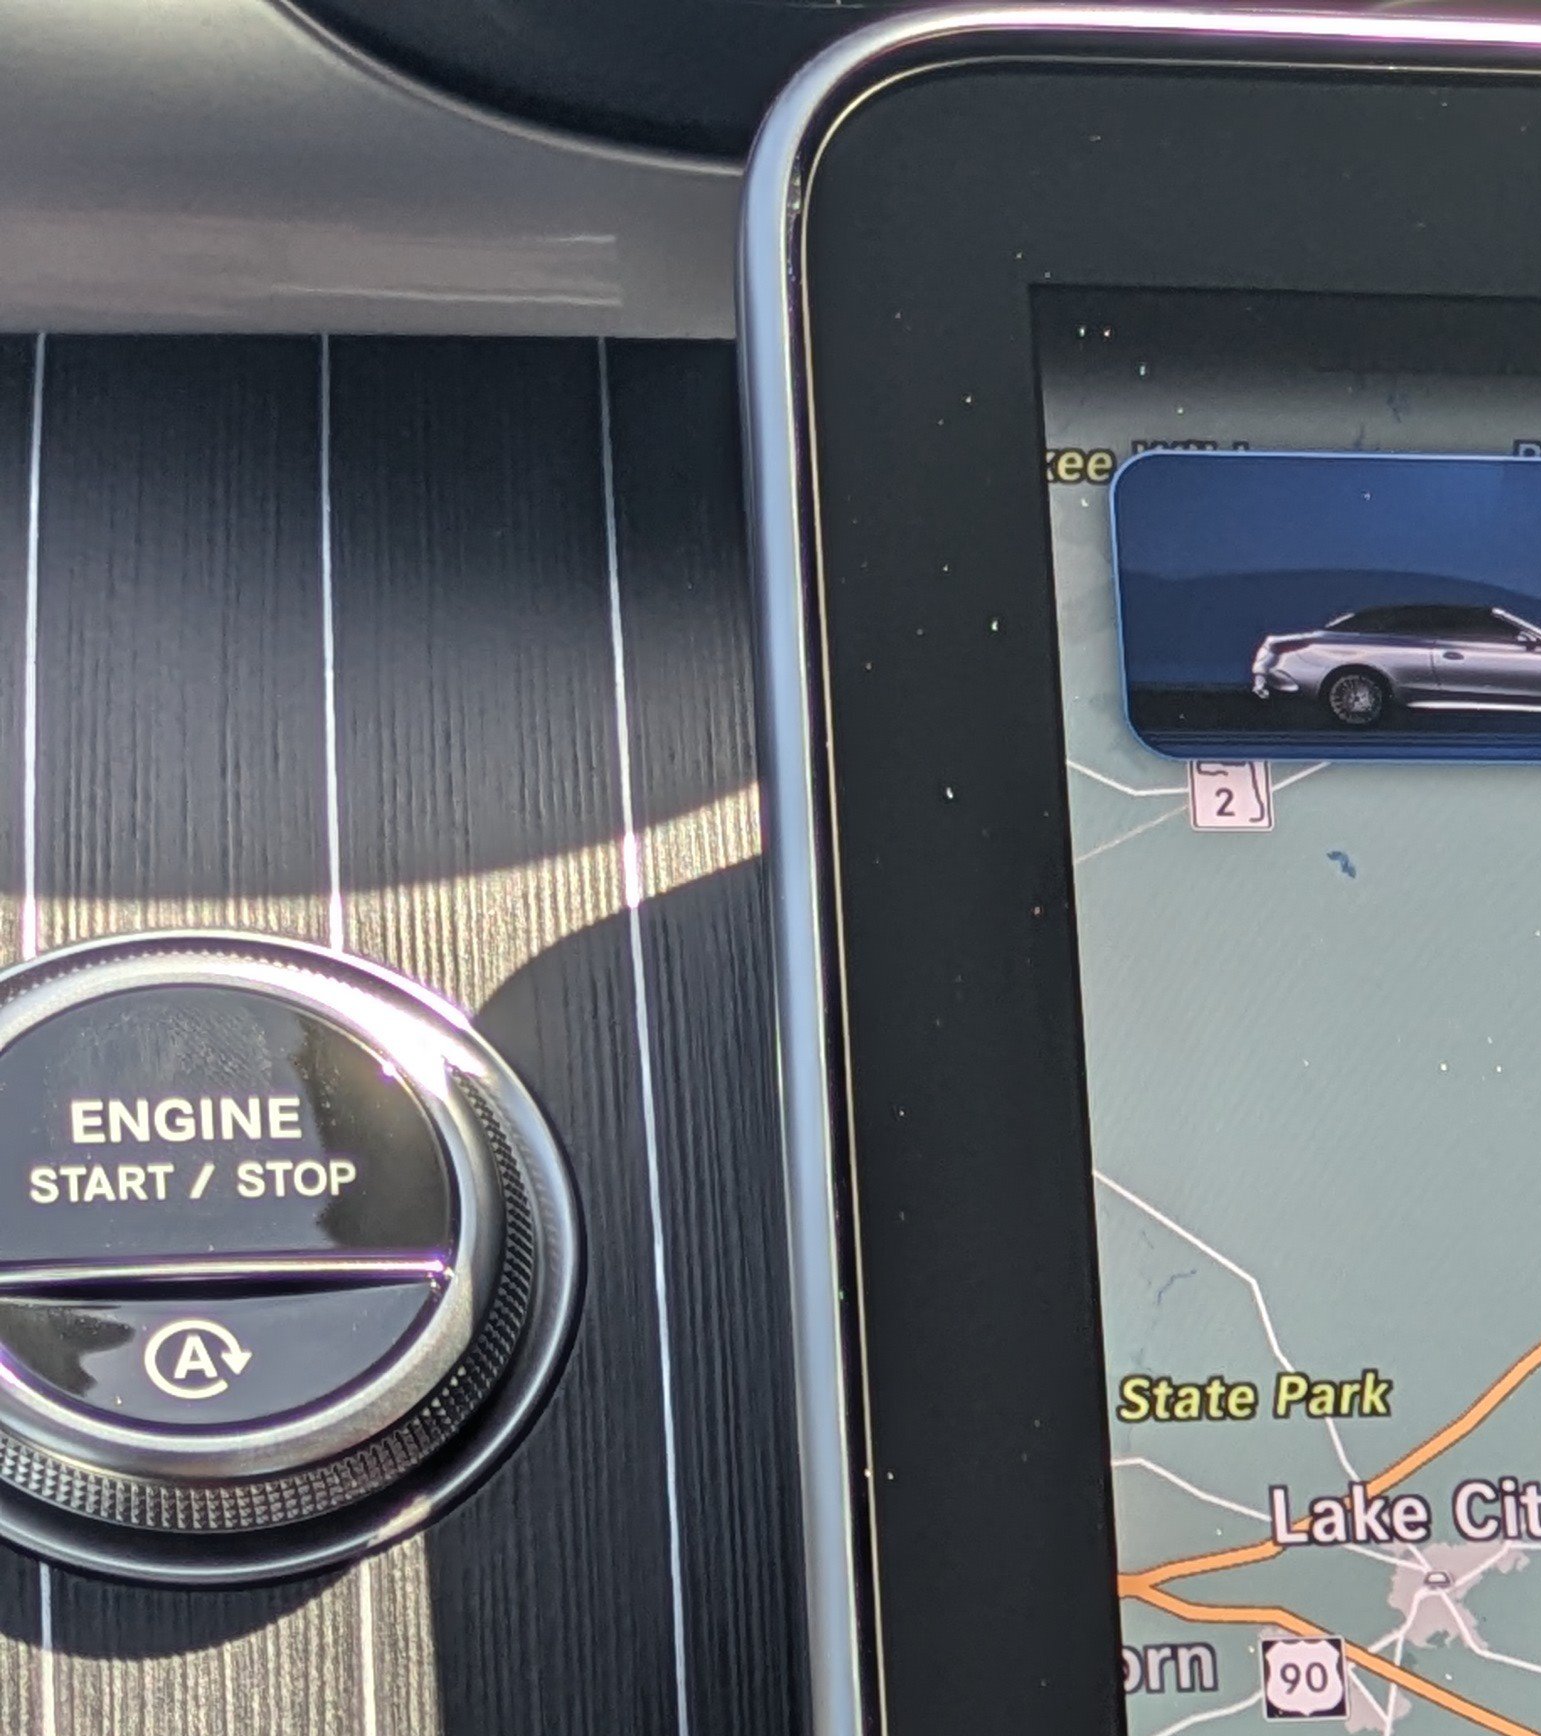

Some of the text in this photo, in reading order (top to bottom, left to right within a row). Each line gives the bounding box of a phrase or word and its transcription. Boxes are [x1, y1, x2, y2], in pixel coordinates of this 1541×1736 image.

[1213, 788, 1238, 819] 2
[71, 1096, 302, 1143] ENGINE
[30, 1164, 174, 1202] START
[236, 1161, 357, 1199] STOP
[1117, 1371, 1392, 1425] State Park
[1269, 1485, 1433, 1547] Lake
[1279, 1661, 1329, 1695] 90
